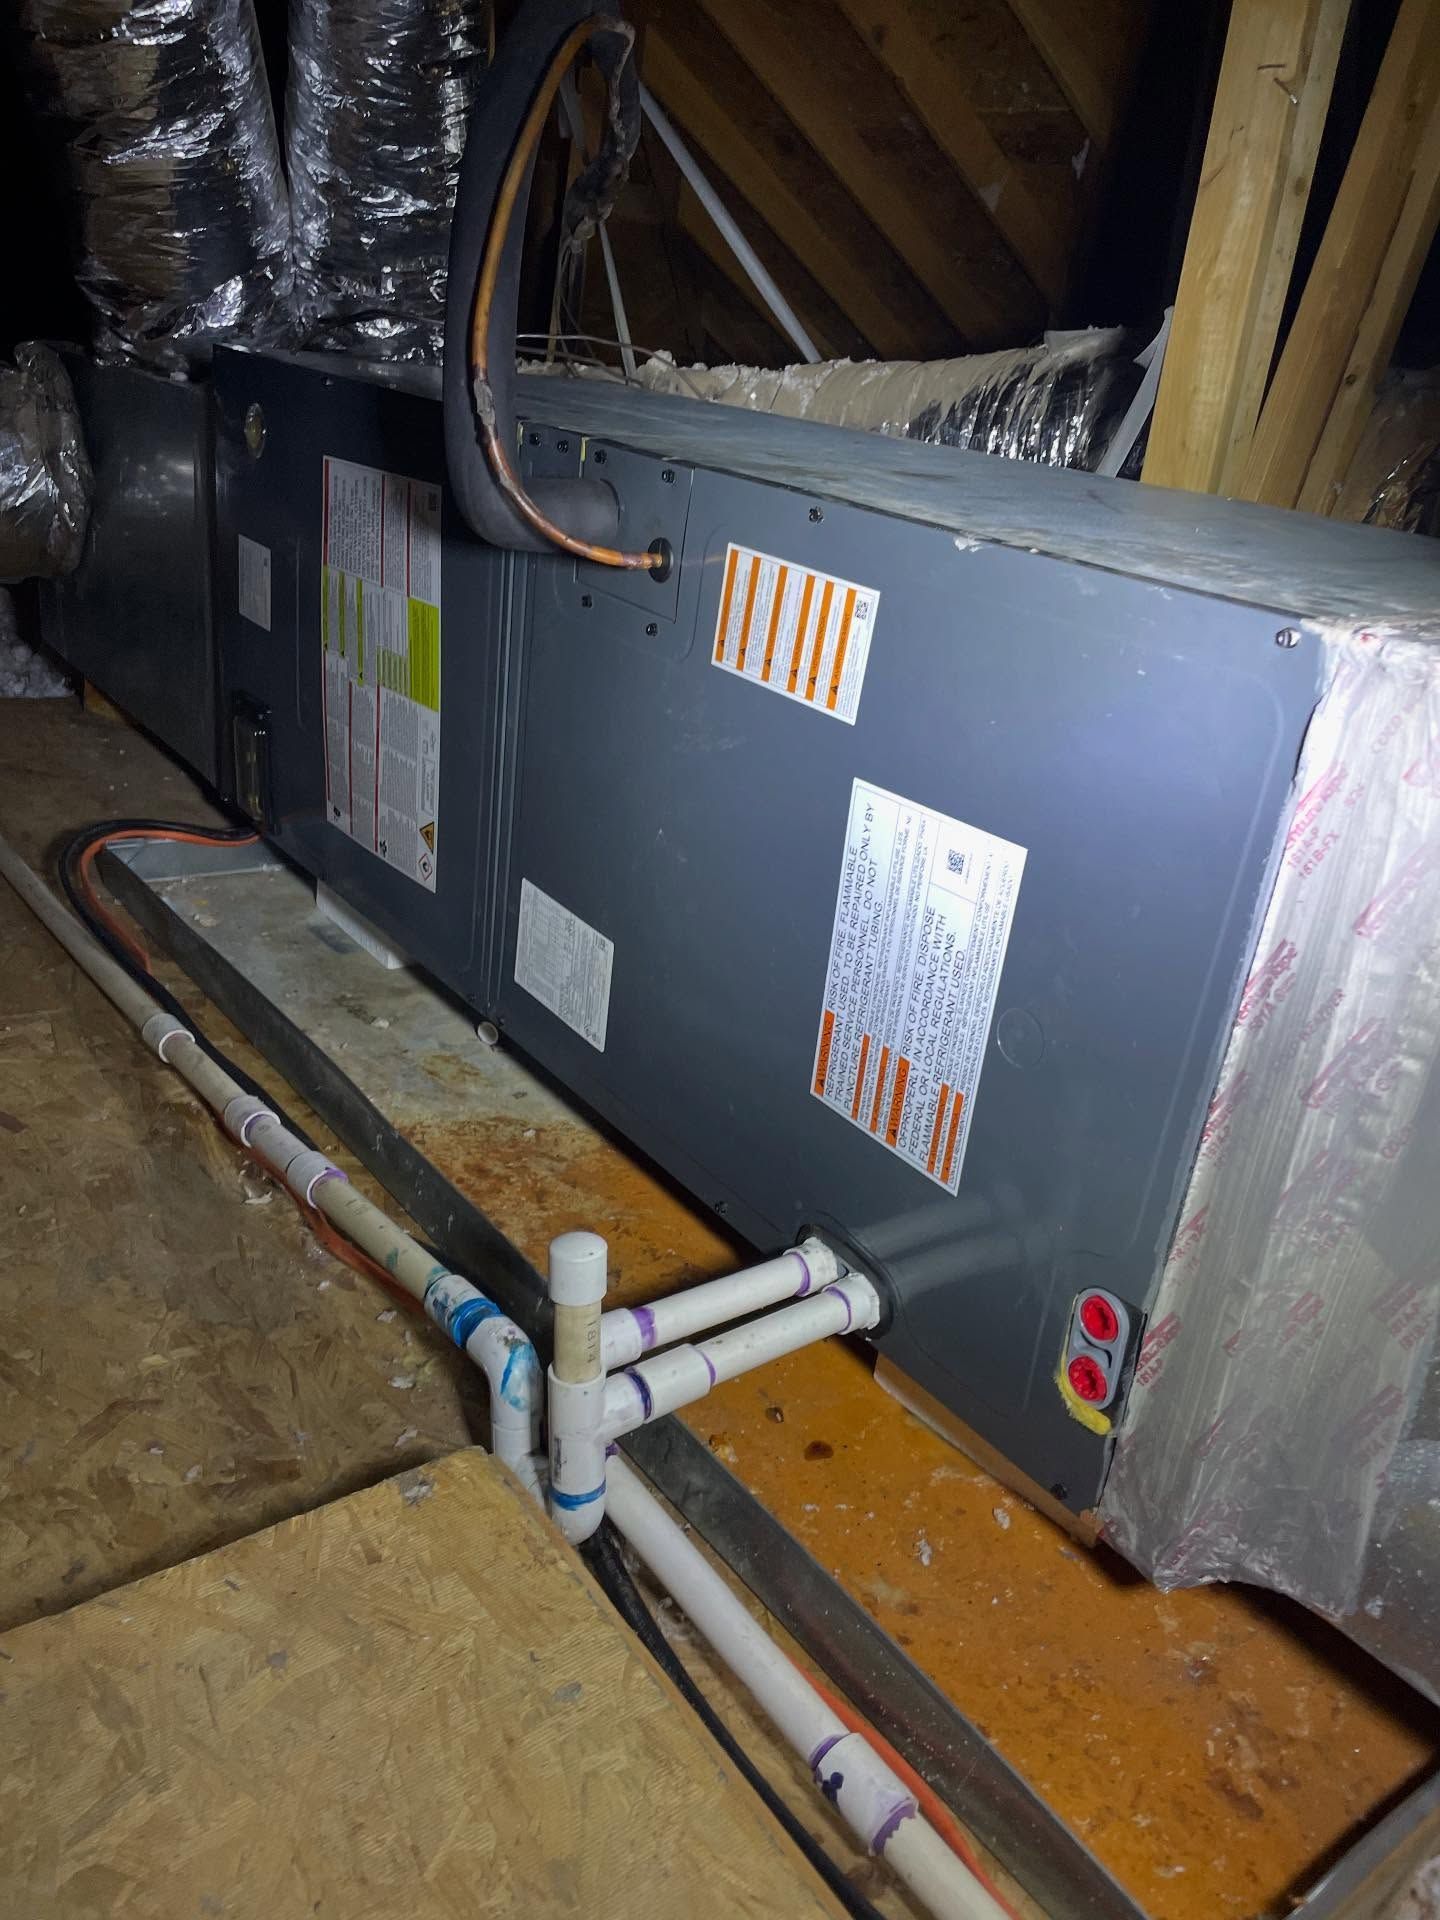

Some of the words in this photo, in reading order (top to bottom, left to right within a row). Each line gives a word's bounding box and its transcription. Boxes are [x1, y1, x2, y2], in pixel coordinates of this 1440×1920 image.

[864, 801, 875, 823] BY
[858, 823, 872, 862] ONLY
[839, 844, 857, 924] FLAMMABLE
[865, 857, 878, 889] NOT
[849, 862, 866, 931] REPAIRED
[862, 888, 873, 911] DO
[834, 925, 846, 959] FIRE.
[846, 930, 856, 951] BE
[917, 904, 935, 966] DISPOSE
[931, 913, 946, 952] WITH
[831, 958, 841, 980] OF
[843, 950, 853, 970] TO
[930, 928, 956, 1030] REGULATIONS.
[827, 978, 838, 1011] RISK
[837, 971, 850, 1011] USED.
[843, 1041, 861, 1112] PUNCTURE
[853, 949, 875, 1043] REFRIGERANT
[867, 896, 883, 951] TUBING.
[910, 966, 925, 1003] FIRE.
[915, 949, 940, 1046] ACCORDANCE
[842, 992, 857, 1051] SERVICE
[907, 1001, 919, 1025] OF
[817, 1018, 832, 1080] WARNING
[825, 1008, 845, 1098] REFRIGERANT
[901, 1024, 915, 1057] RISK
[912, 1045, 923, 1063] IN
[918, 1085, 940, 1163] FLAMMABLE
[932, 987, 958, 1086] REFRIGERANT
[950, 945, 966, 990] USED.
[922, 1029, 938, 1075] LOCAL
[834, 1049, 849, 1105] TRAINED
[889, 1065, 907, 1129] WARNING
[918, 1074, 930, 1098] OR
[897, 1061, 920, 1149] OFPROPERLY
[908, 1096, 926, 1156] FEDERAL
